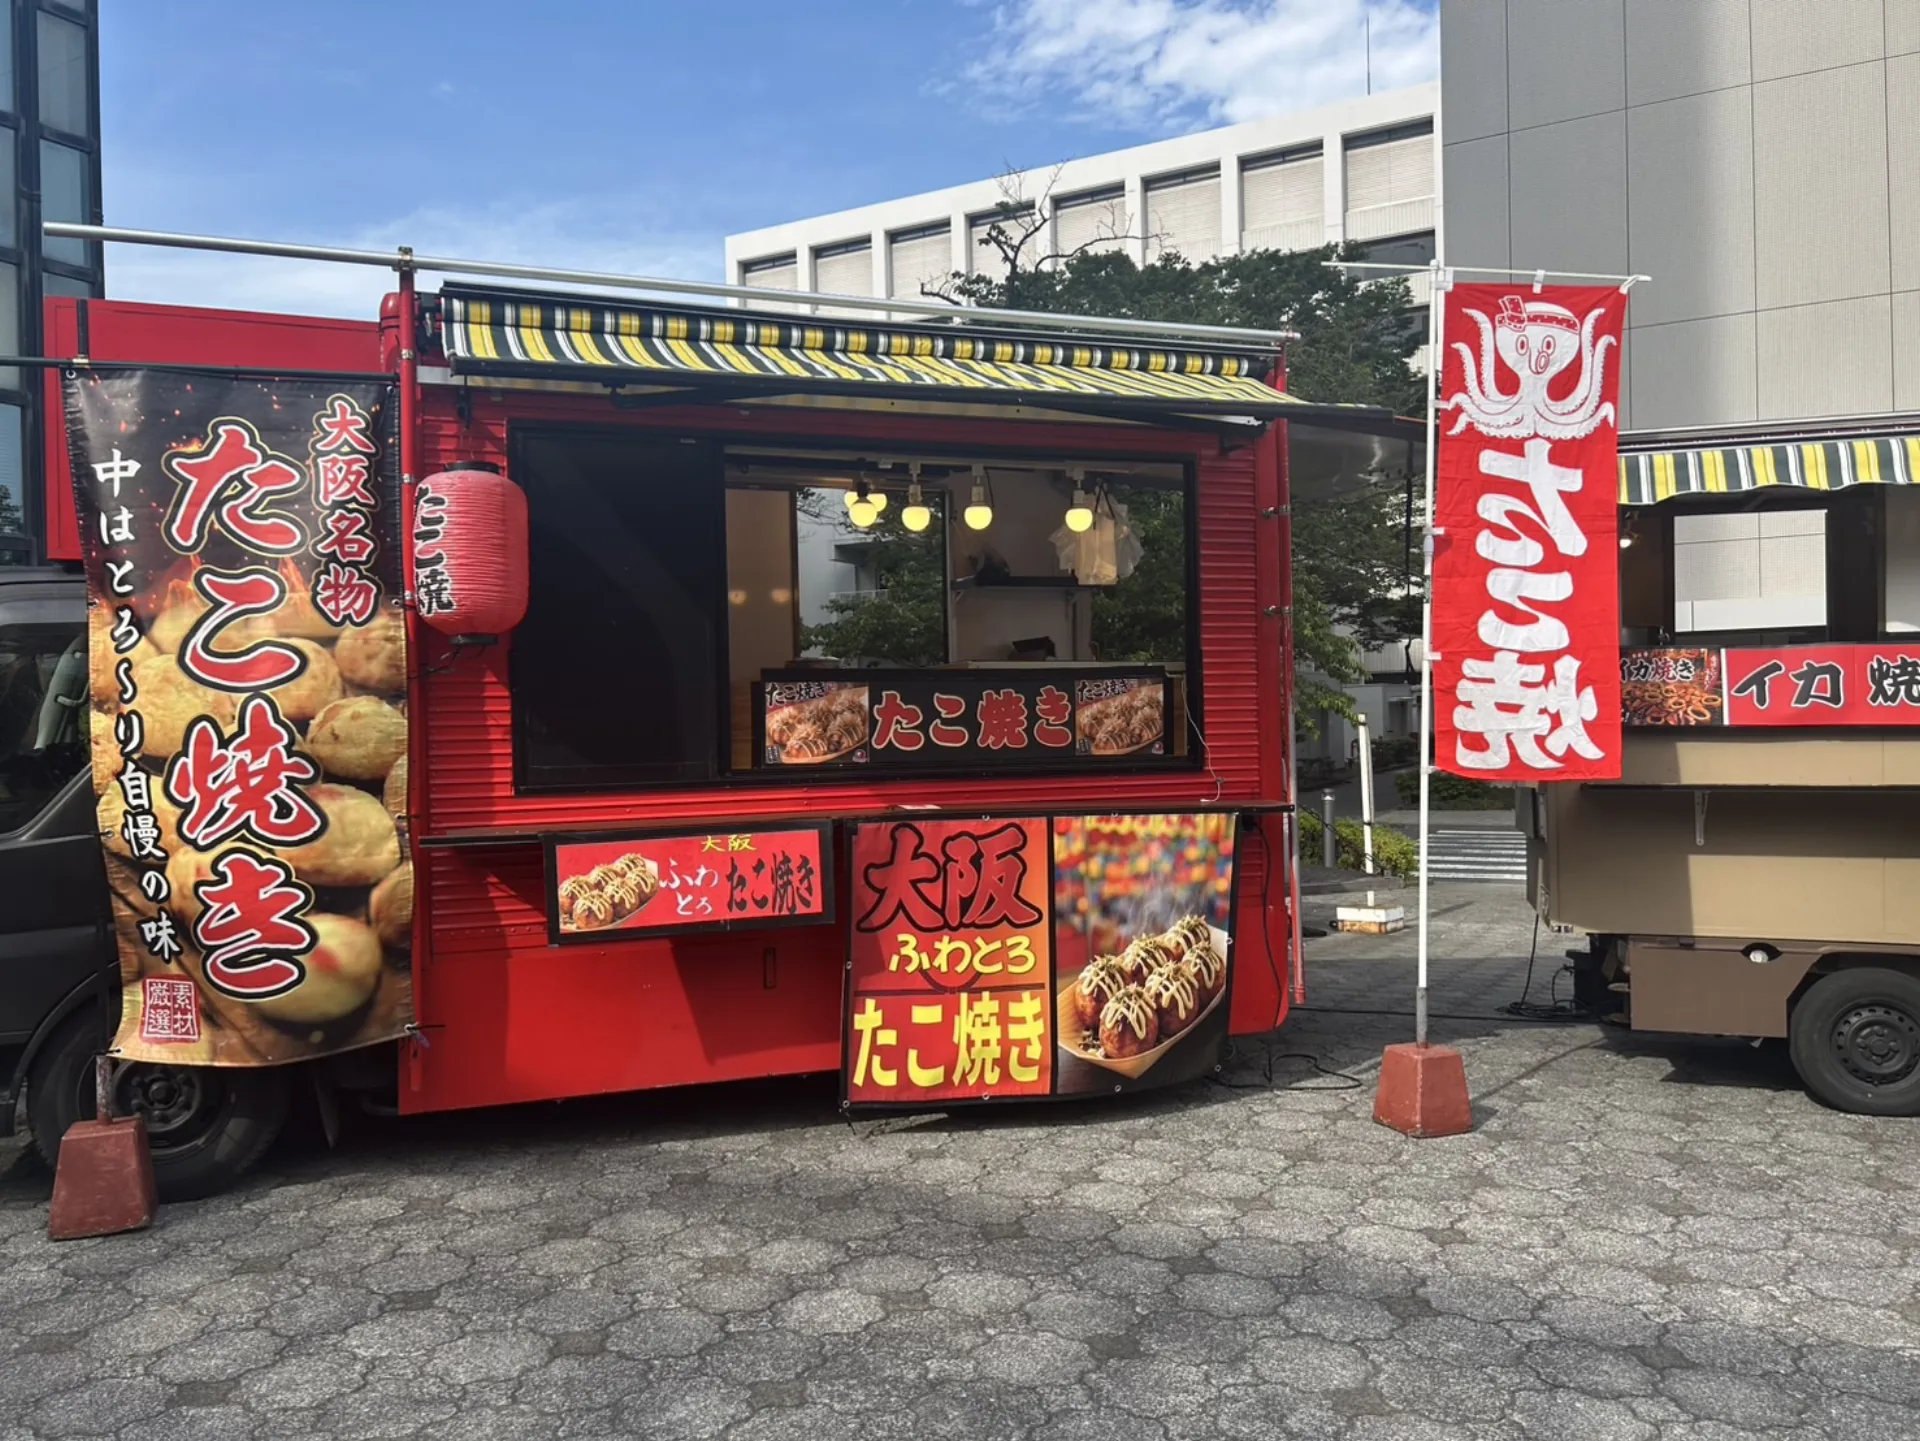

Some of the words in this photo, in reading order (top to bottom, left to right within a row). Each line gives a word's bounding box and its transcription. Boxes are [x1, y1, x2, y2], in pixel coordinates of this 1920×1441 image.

[315, 398, 380, 625] 大阪名物
[413, 484, 458, 617] たこ焼
[169, 423, 323, 995] たこ焼き
[871, 685, 1074, 751] たこ焼き
[659, 858, 719, 889] ふわ
[701, 834, 756, 852] 大阪
[675, 891, 713, 916] とろ
[725, 850, 816, 915] たこ焼き
[856, 822, 1044, 933] 大阪
[889, 934, 1037, 974] ふわとろ
[852, 991, 1046, 1088] たこ焼き
